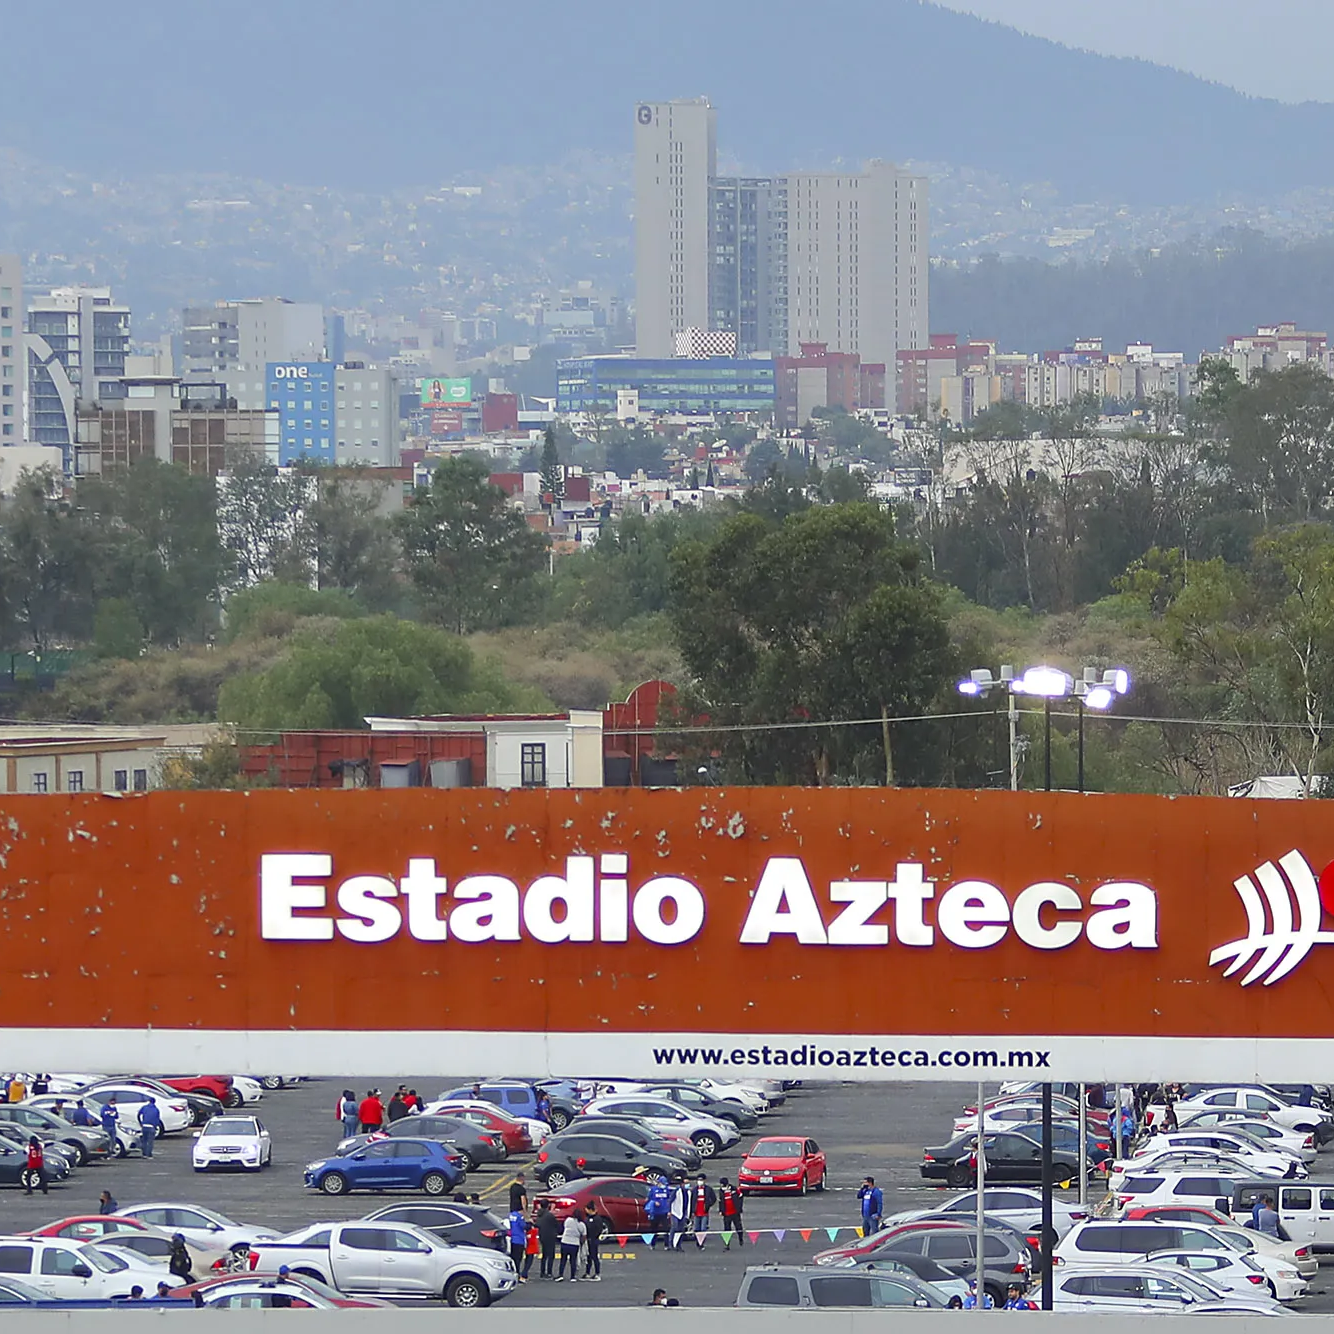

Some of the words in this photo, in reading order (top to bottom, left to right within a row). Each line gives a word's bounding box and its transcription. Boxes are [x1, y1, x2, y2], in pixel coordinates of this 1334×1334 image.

[275, 365, 308, 379] one
[261, 852, 706, 944] Estadio
[739, 856, 1159, 949] Azteca
[653, 1045, 1051, 1067] www.estadioazteca.com.mx
